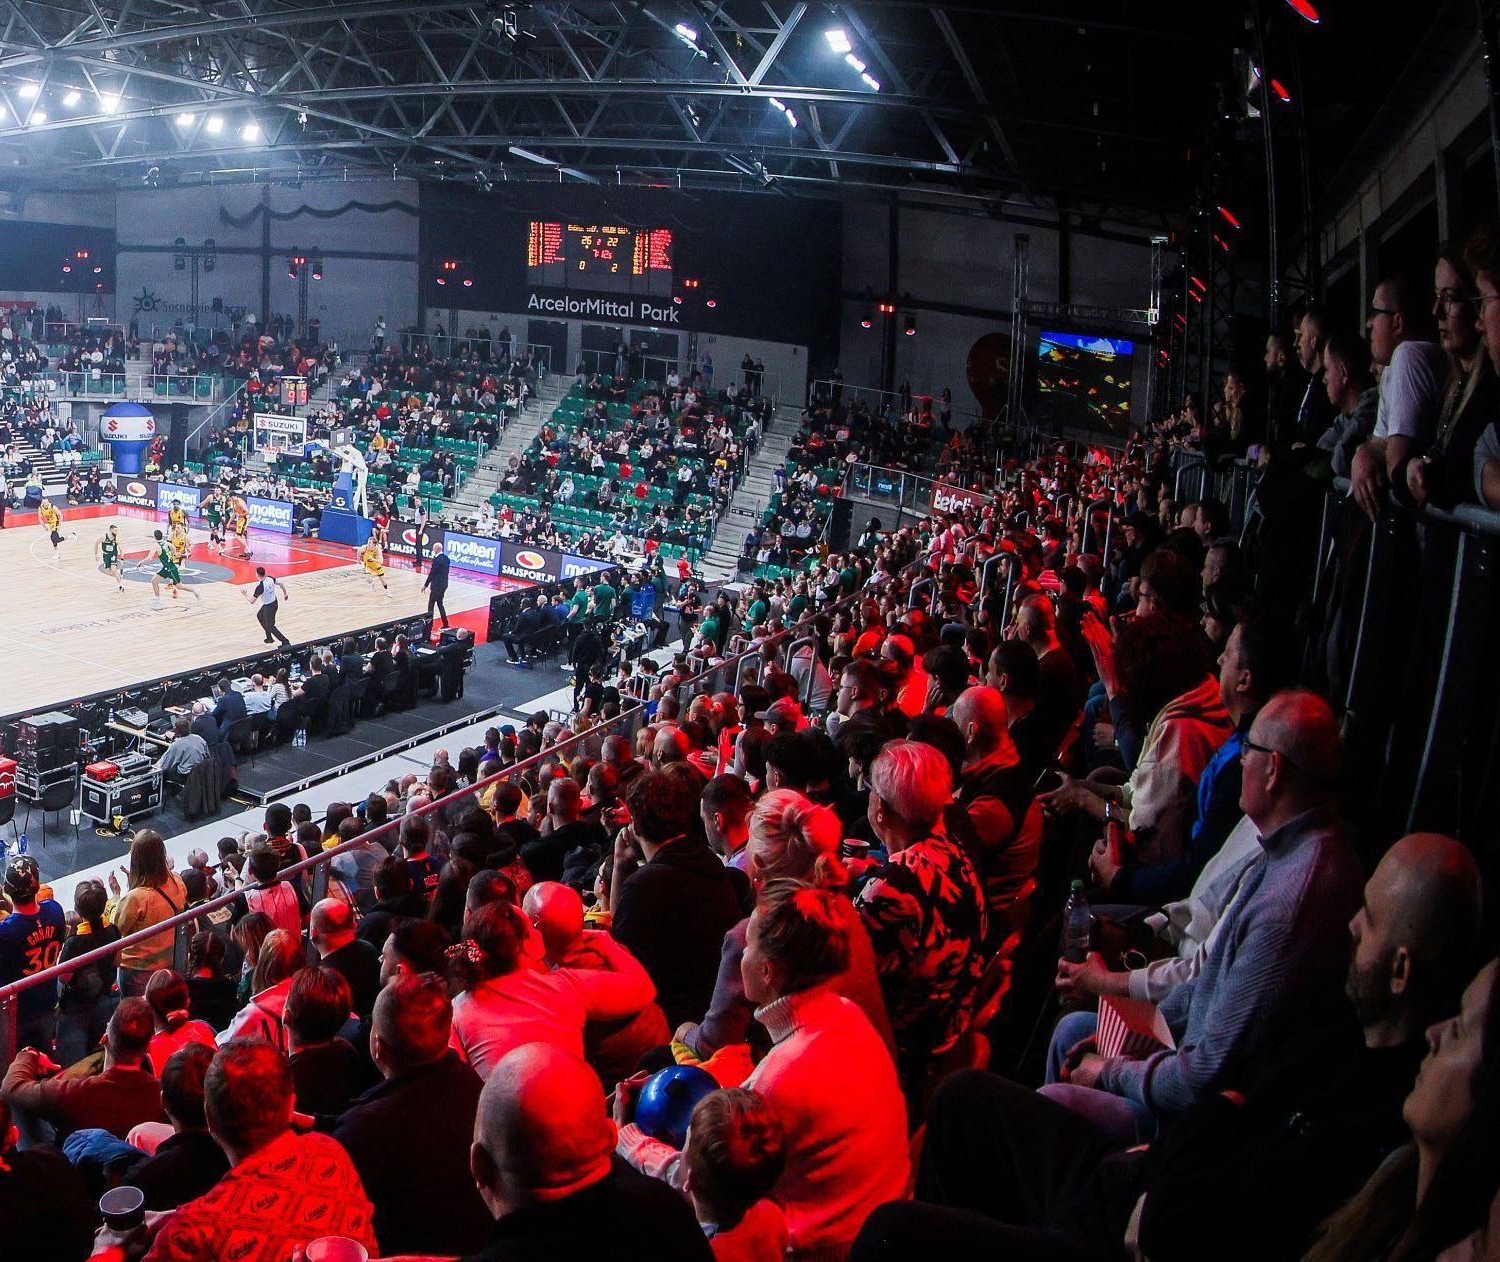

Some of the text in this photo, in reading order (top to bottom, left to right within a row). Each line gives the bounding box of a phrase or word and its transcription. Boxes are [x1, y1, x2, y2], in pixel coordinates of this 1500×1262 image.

[528, 293, 679, 323] ArcelorMittal Park
[268, 421, 298, 430] SUZUKI
[161, 489, 197, 505] molten
[250, 503, 290, 520] molten
[448, 539, 496, 560] molten
[22, 940, 61, 976] 30
